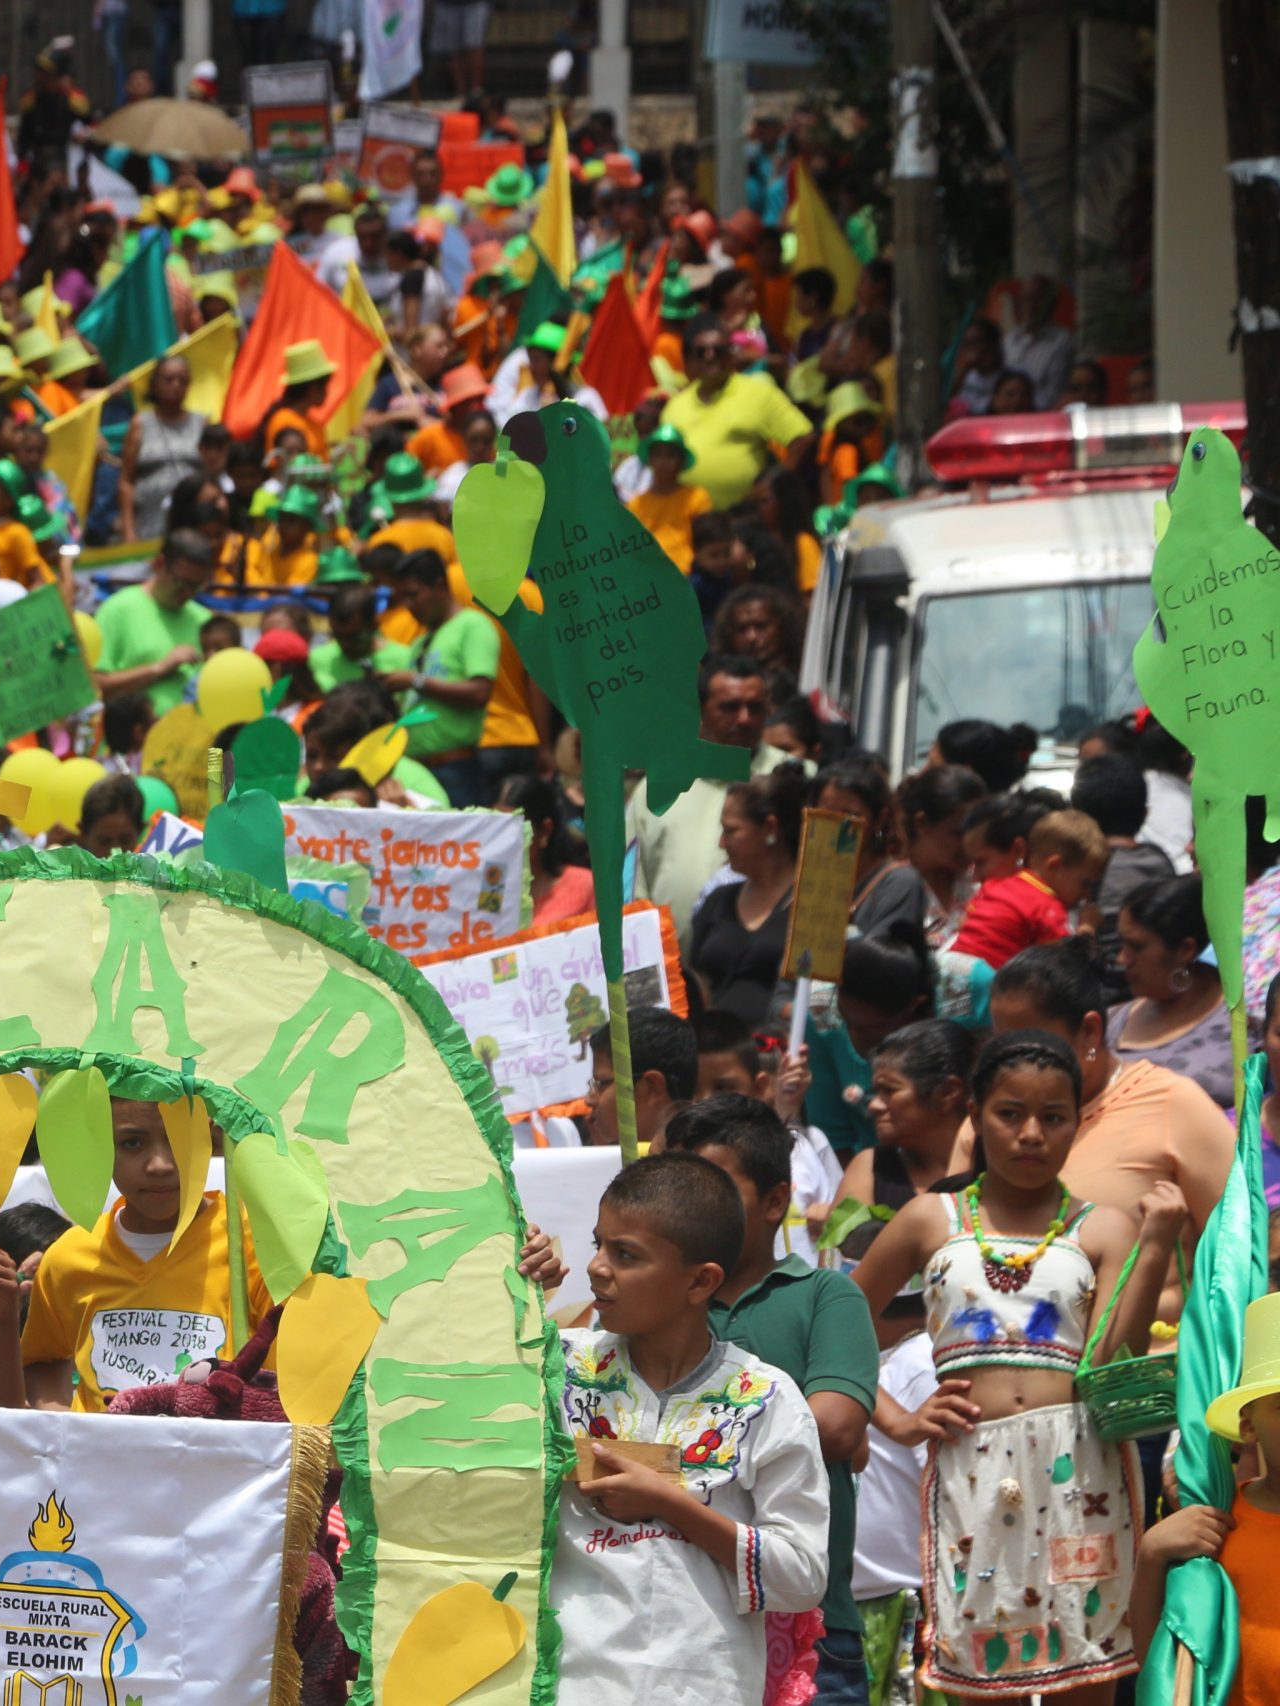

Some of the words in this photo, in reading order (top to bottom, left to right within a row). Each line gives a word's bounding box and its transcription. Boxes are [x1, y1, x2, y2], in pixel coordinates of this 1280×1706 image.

[560, 519, 589, 548] La
[538, 530, 656, 585] naturaleza
[558, 589, 581, 609] es
[589, 575, 618, 593] la
[1163, 550, 1280, 611] Cuidemos
[1209, 604, 1235, 630] la
[599, 629, 638, 661] del
[1181, 639, 1248, 675] Flora
[1184, 687, 1272, 723] Fauna.
[438, 975, 490, 1008] bra
[101, 1311, 168, 1329] FESTIVAL
[177, 1314, 217, 1333] DEL
[106, 1330, 161, 1347] MANGO
[170, 1332, 207, 1351] 2018
[28, 1612, 71, 1628] MIXTA
[61, 1602, 109, 1618] RURAL
[5, 1630, 89, 1652] BARACK
[6, 1651, 85, 1672] ELOHIM
